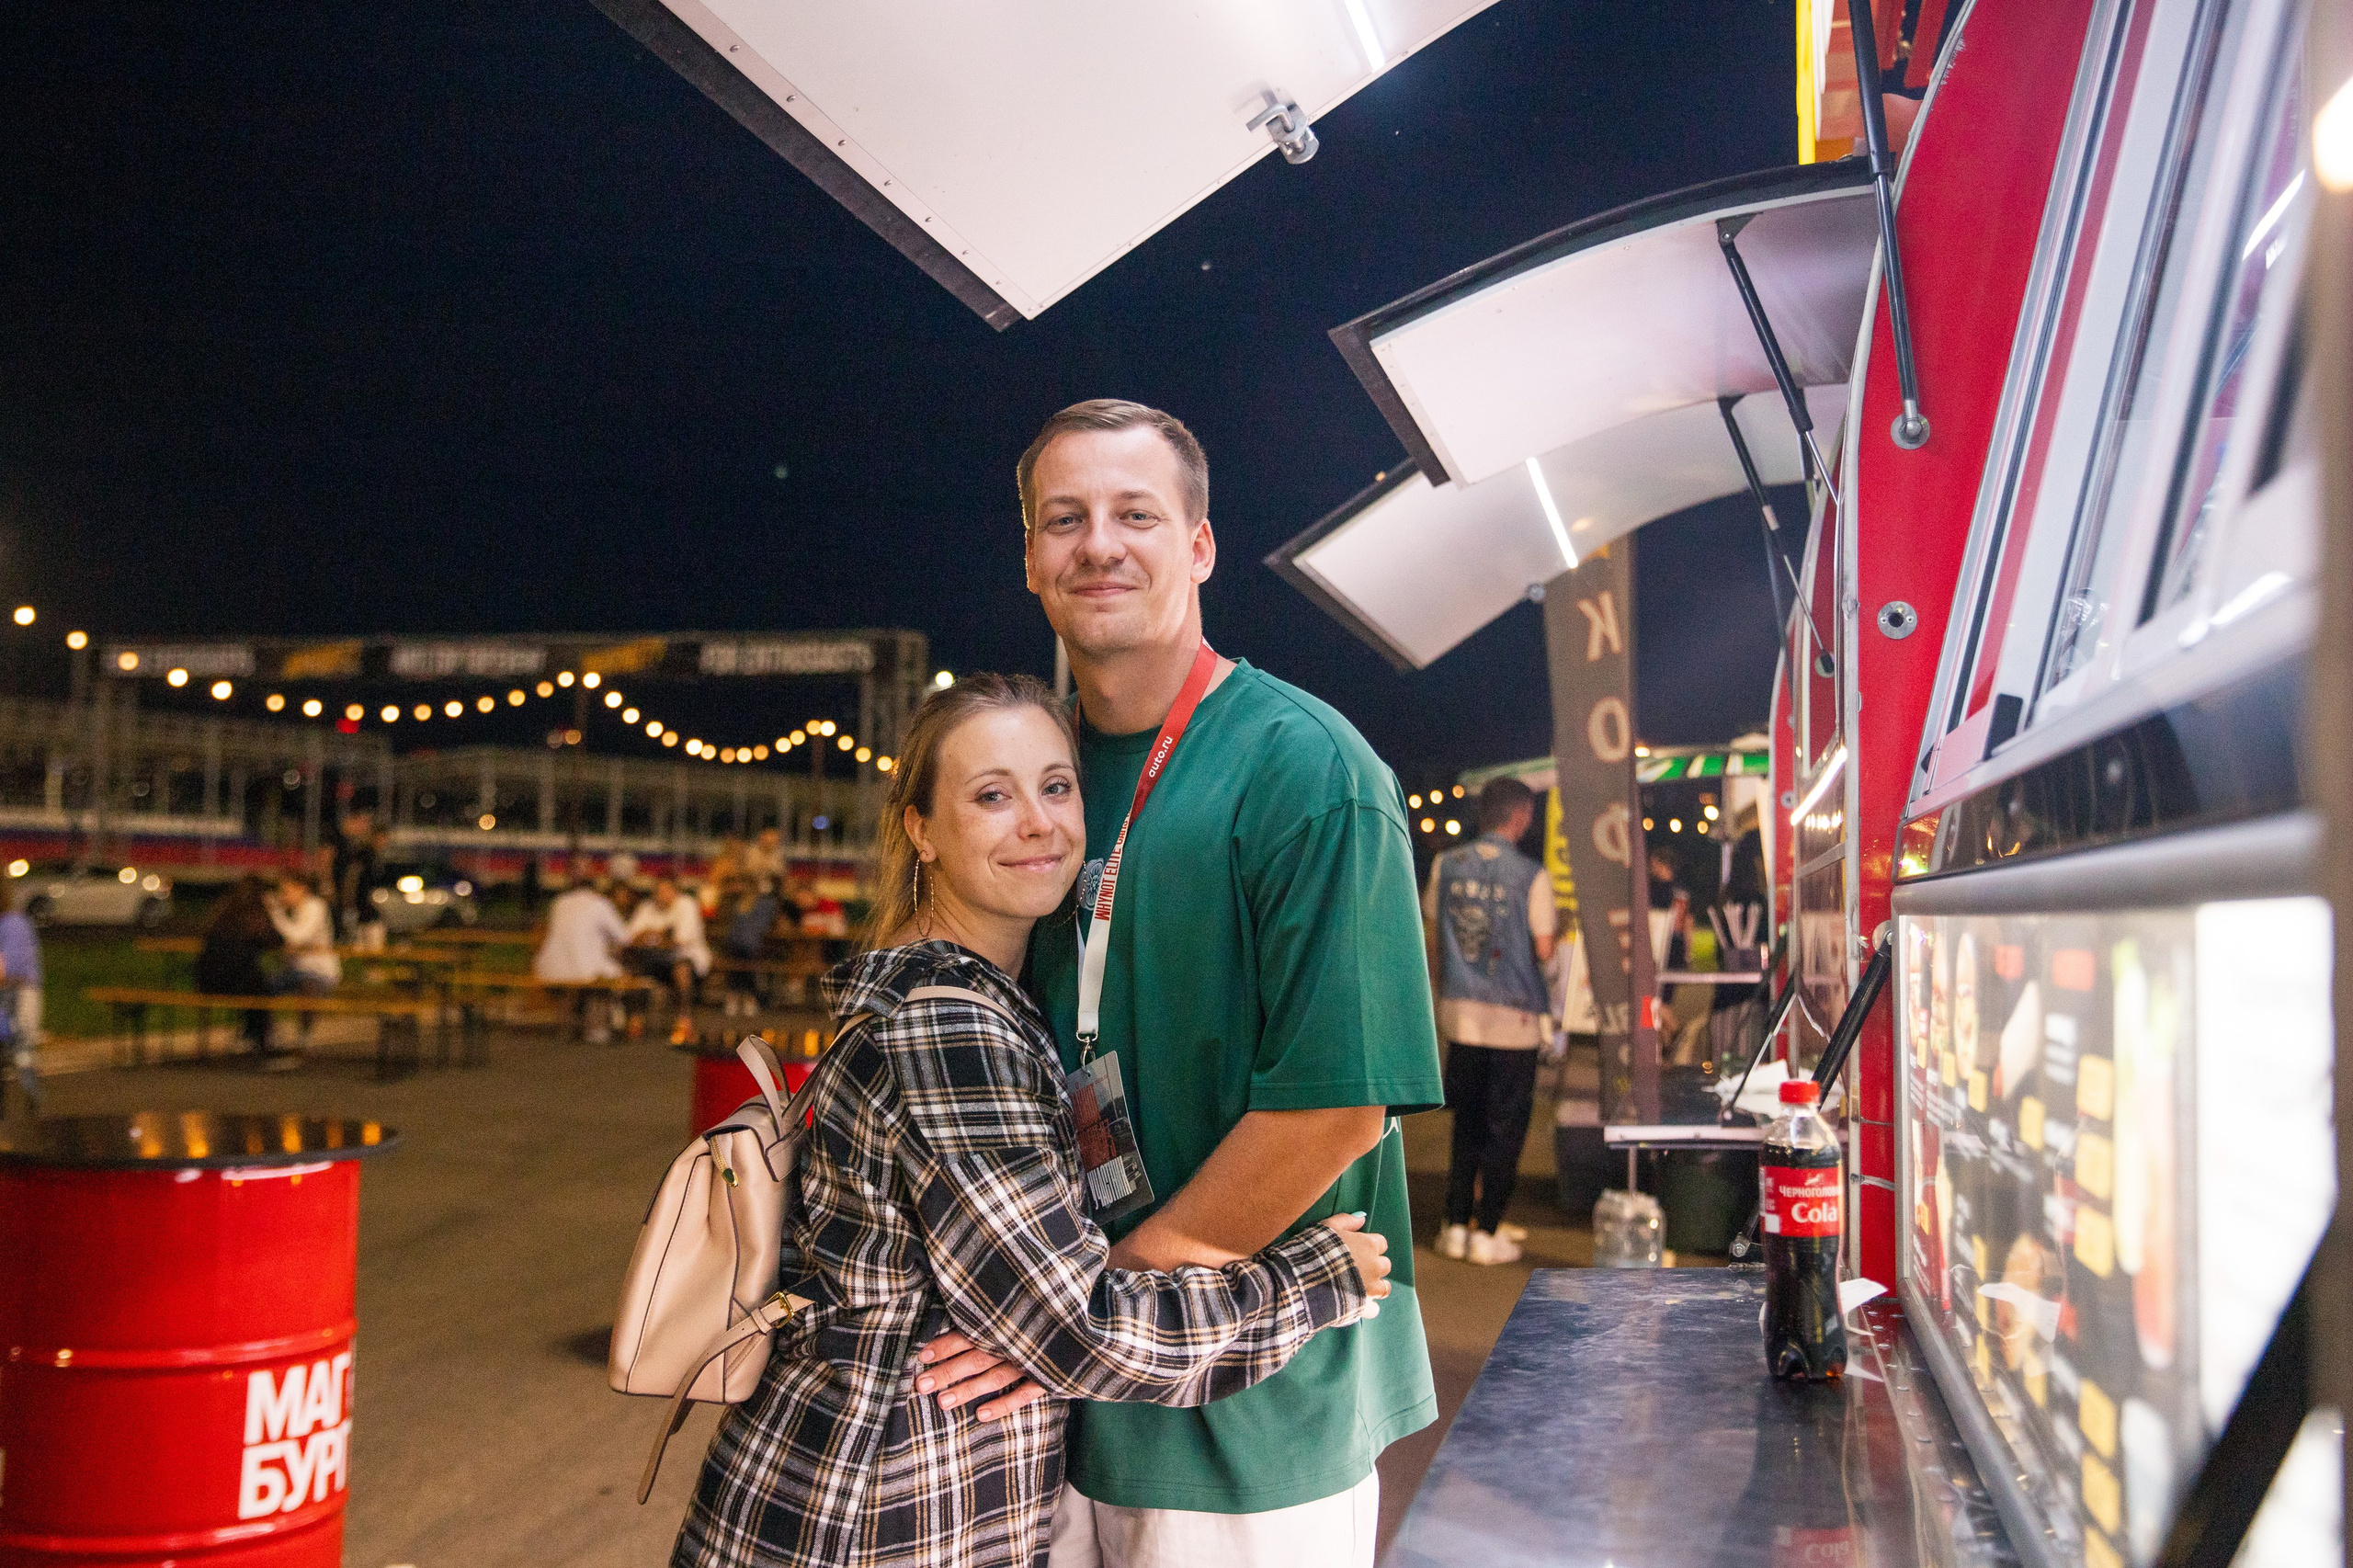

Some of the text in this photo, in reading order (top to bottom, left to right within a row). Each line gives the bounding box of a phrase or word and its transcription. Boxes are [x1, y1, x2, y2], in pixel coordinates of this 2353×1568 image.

[1148, 736, 1173, 778] auto.ru
[1094, 878, 1115, 921] WHYNOT
[1791, 1201, 1838, 1223] Cola
